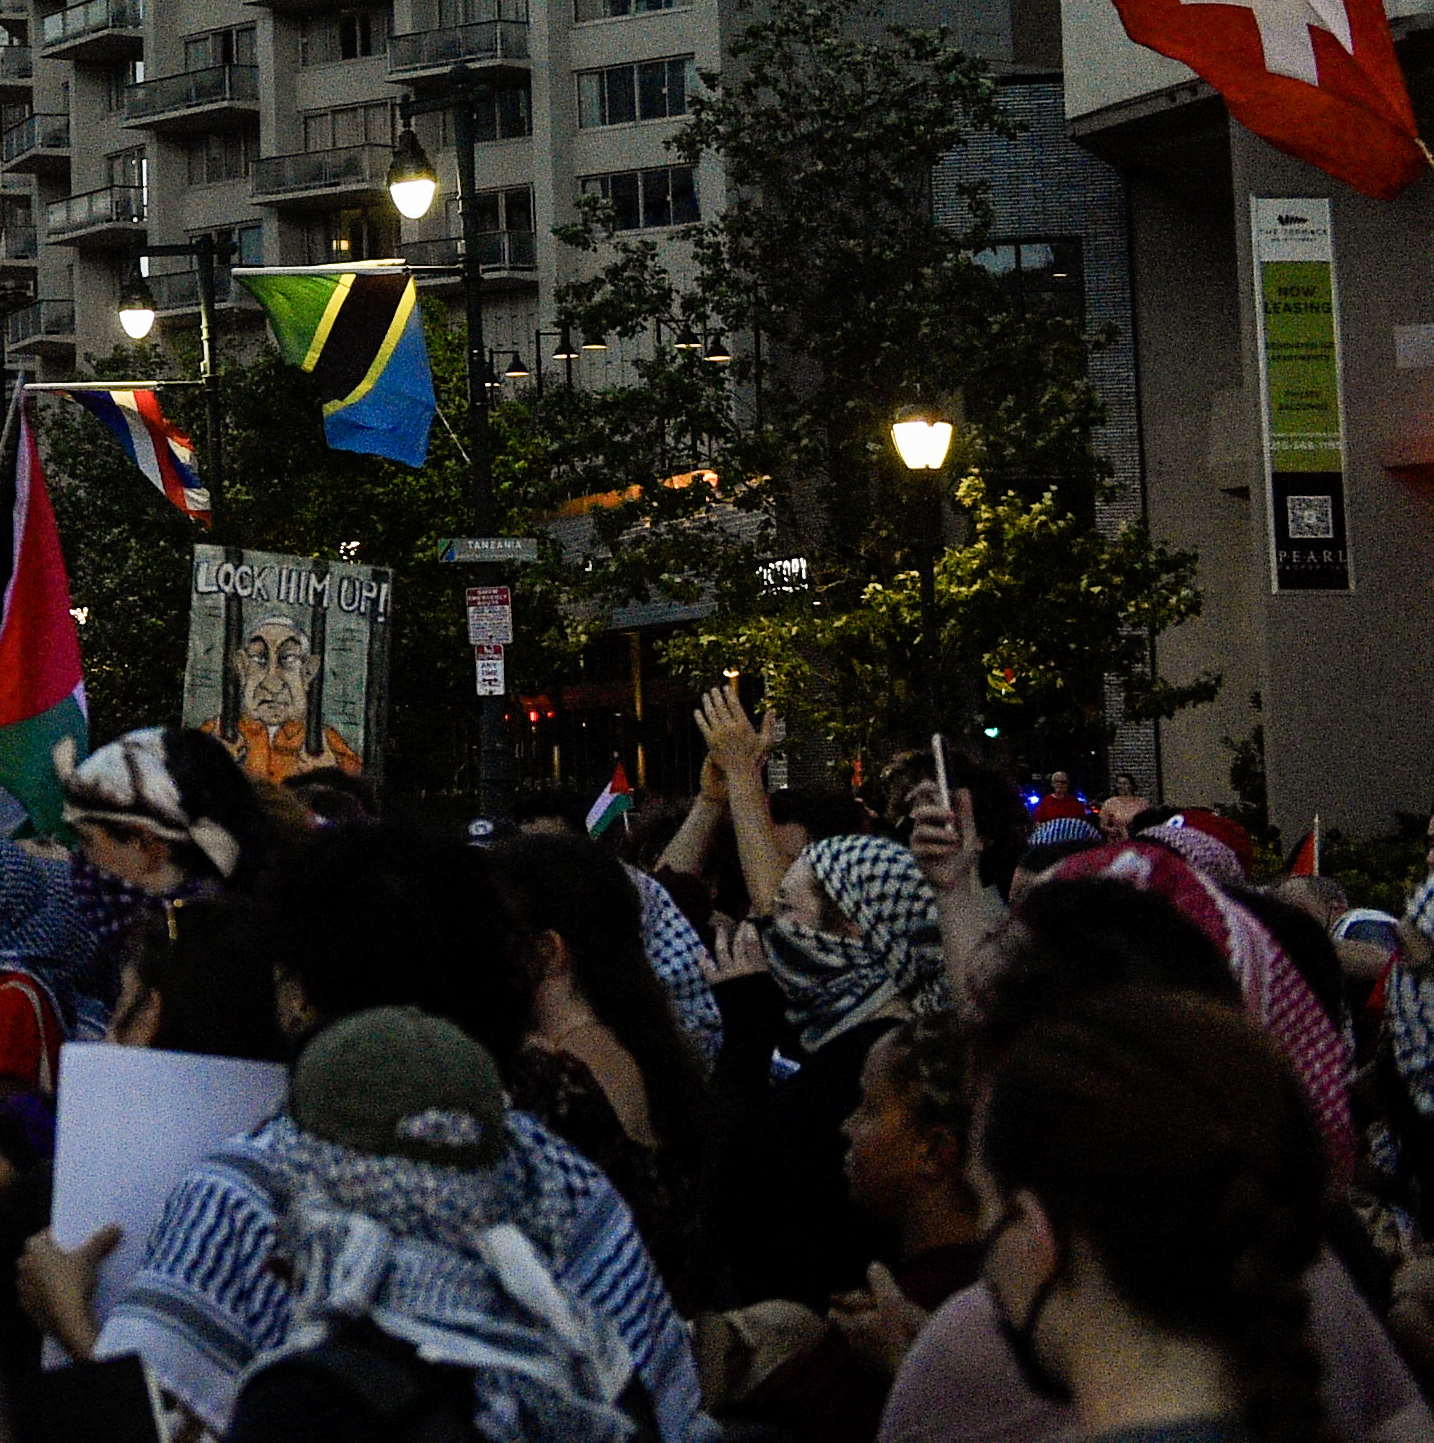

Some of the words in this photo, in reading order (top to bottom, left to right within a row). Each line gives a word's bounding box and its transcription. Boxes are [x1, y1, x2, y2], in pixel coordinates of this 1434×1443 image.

[1277, 285, 1316, 298] NOW
[1264, 301, 1332, 315] LEASING
[195, 560, 269, 602] LOCK
[276, 566, 332, 608] HIM
[338, 575, 389, 623] UP!
